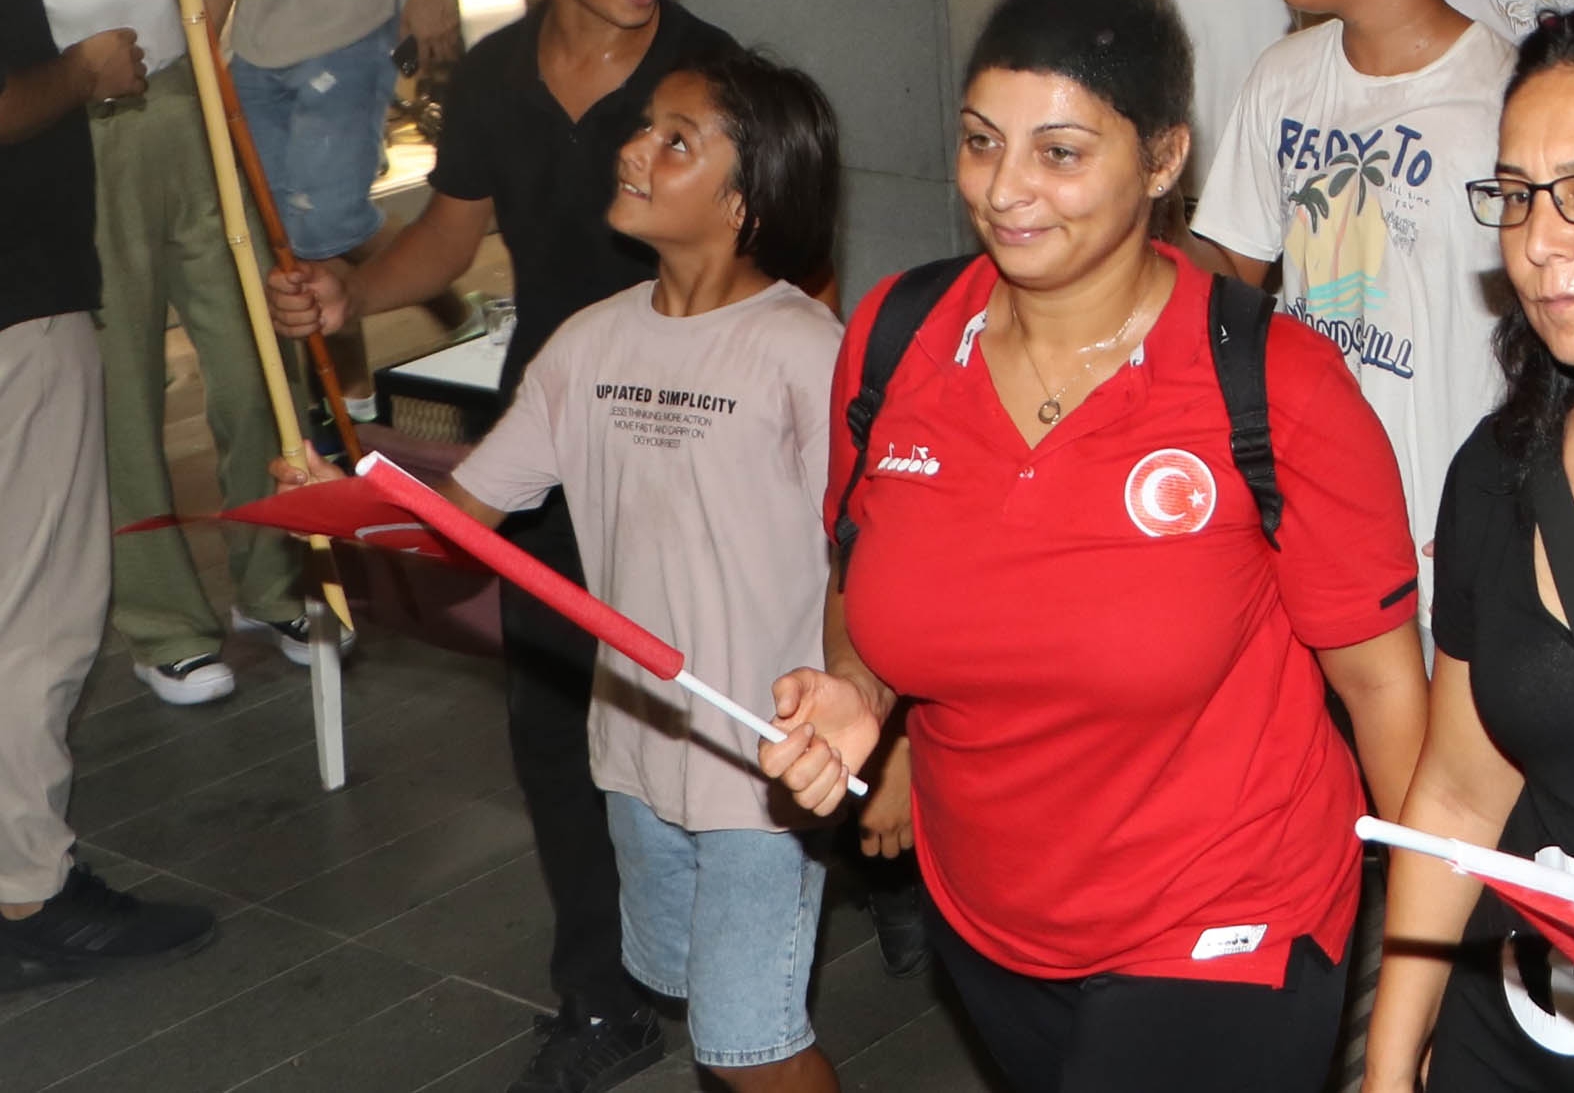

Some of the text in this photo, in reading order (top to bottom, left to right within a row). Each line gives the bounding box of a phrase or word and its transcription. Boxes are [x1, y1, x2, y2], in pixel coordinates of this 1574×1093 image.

[658, 389, 737, 414] SIMPLICITY
[683, 414, 712, 427] ACTION
[691, 428, 705, 439] ON
